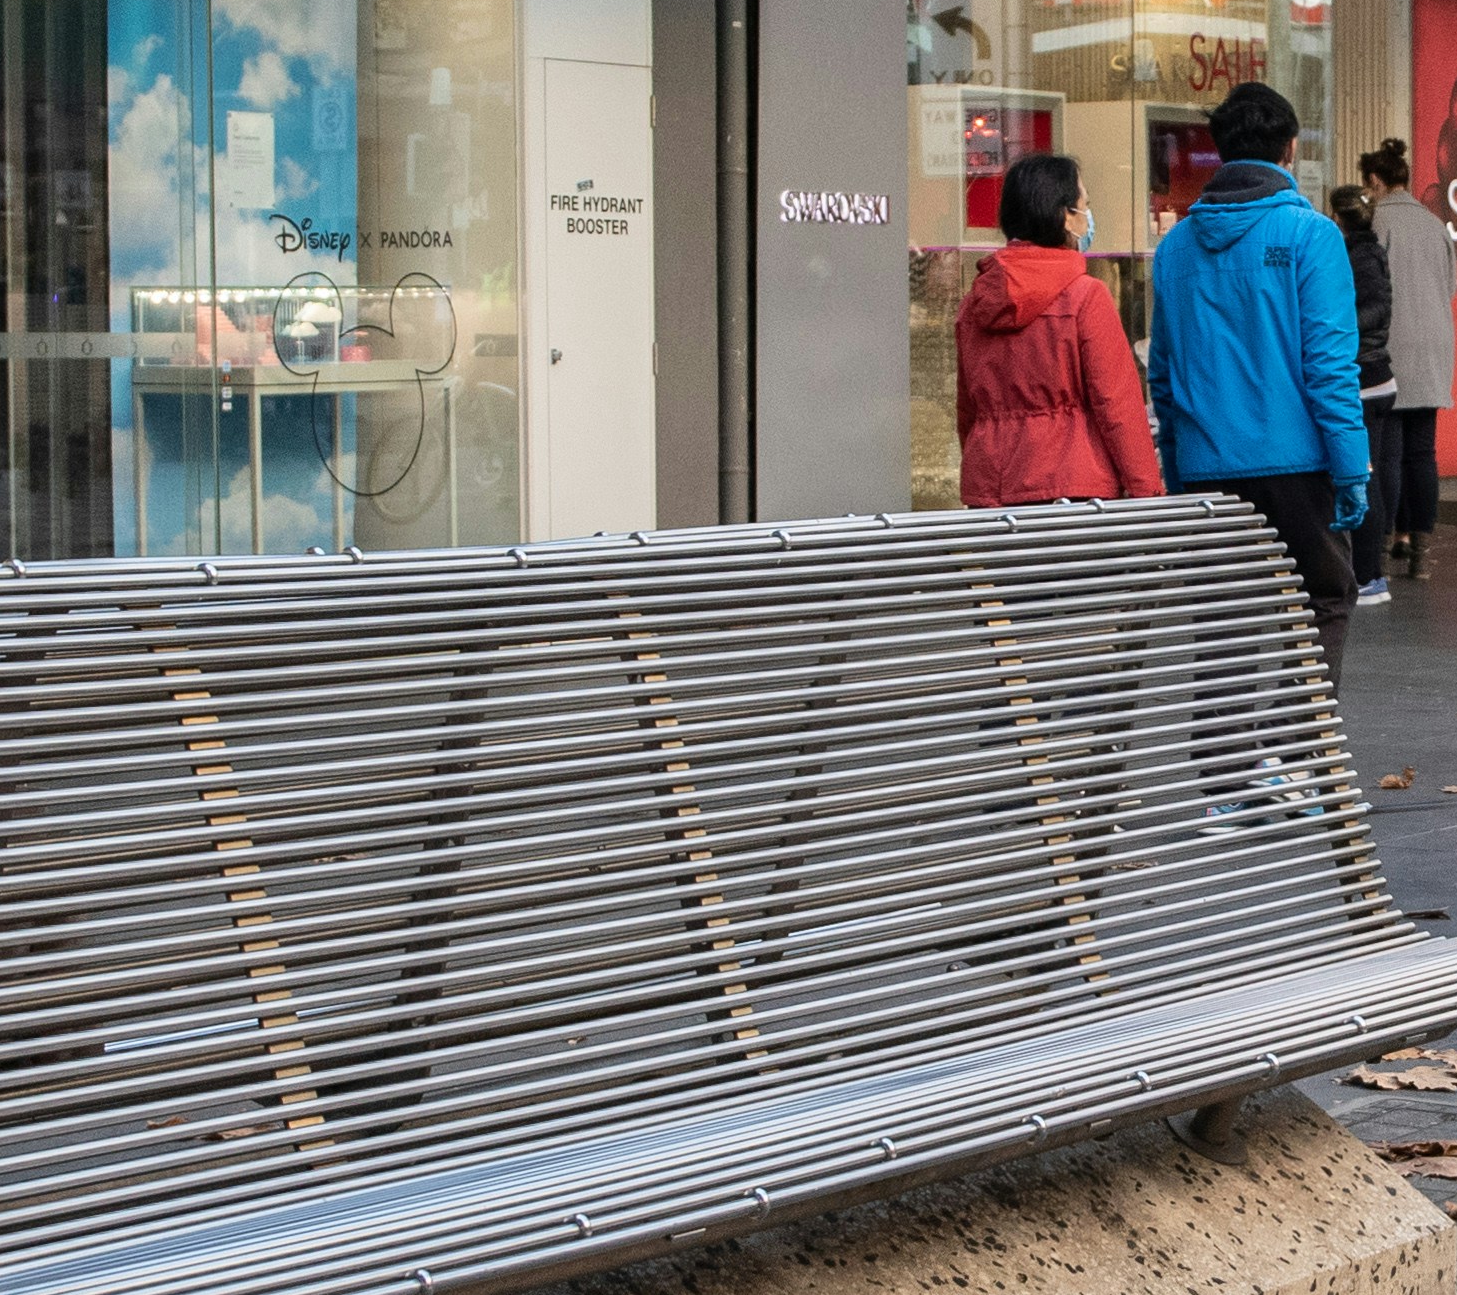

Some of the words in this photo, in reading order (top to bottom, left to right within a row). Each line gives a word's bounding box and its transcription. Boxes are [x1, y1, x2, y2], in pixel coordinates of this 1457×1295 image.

[550, 194, 580, 211] FIRE
[583, 196, 644, 214] HYDRANT
[566, 217, 629, 235] BOOSTER
[380, 226, 453, 248] PANDORA
